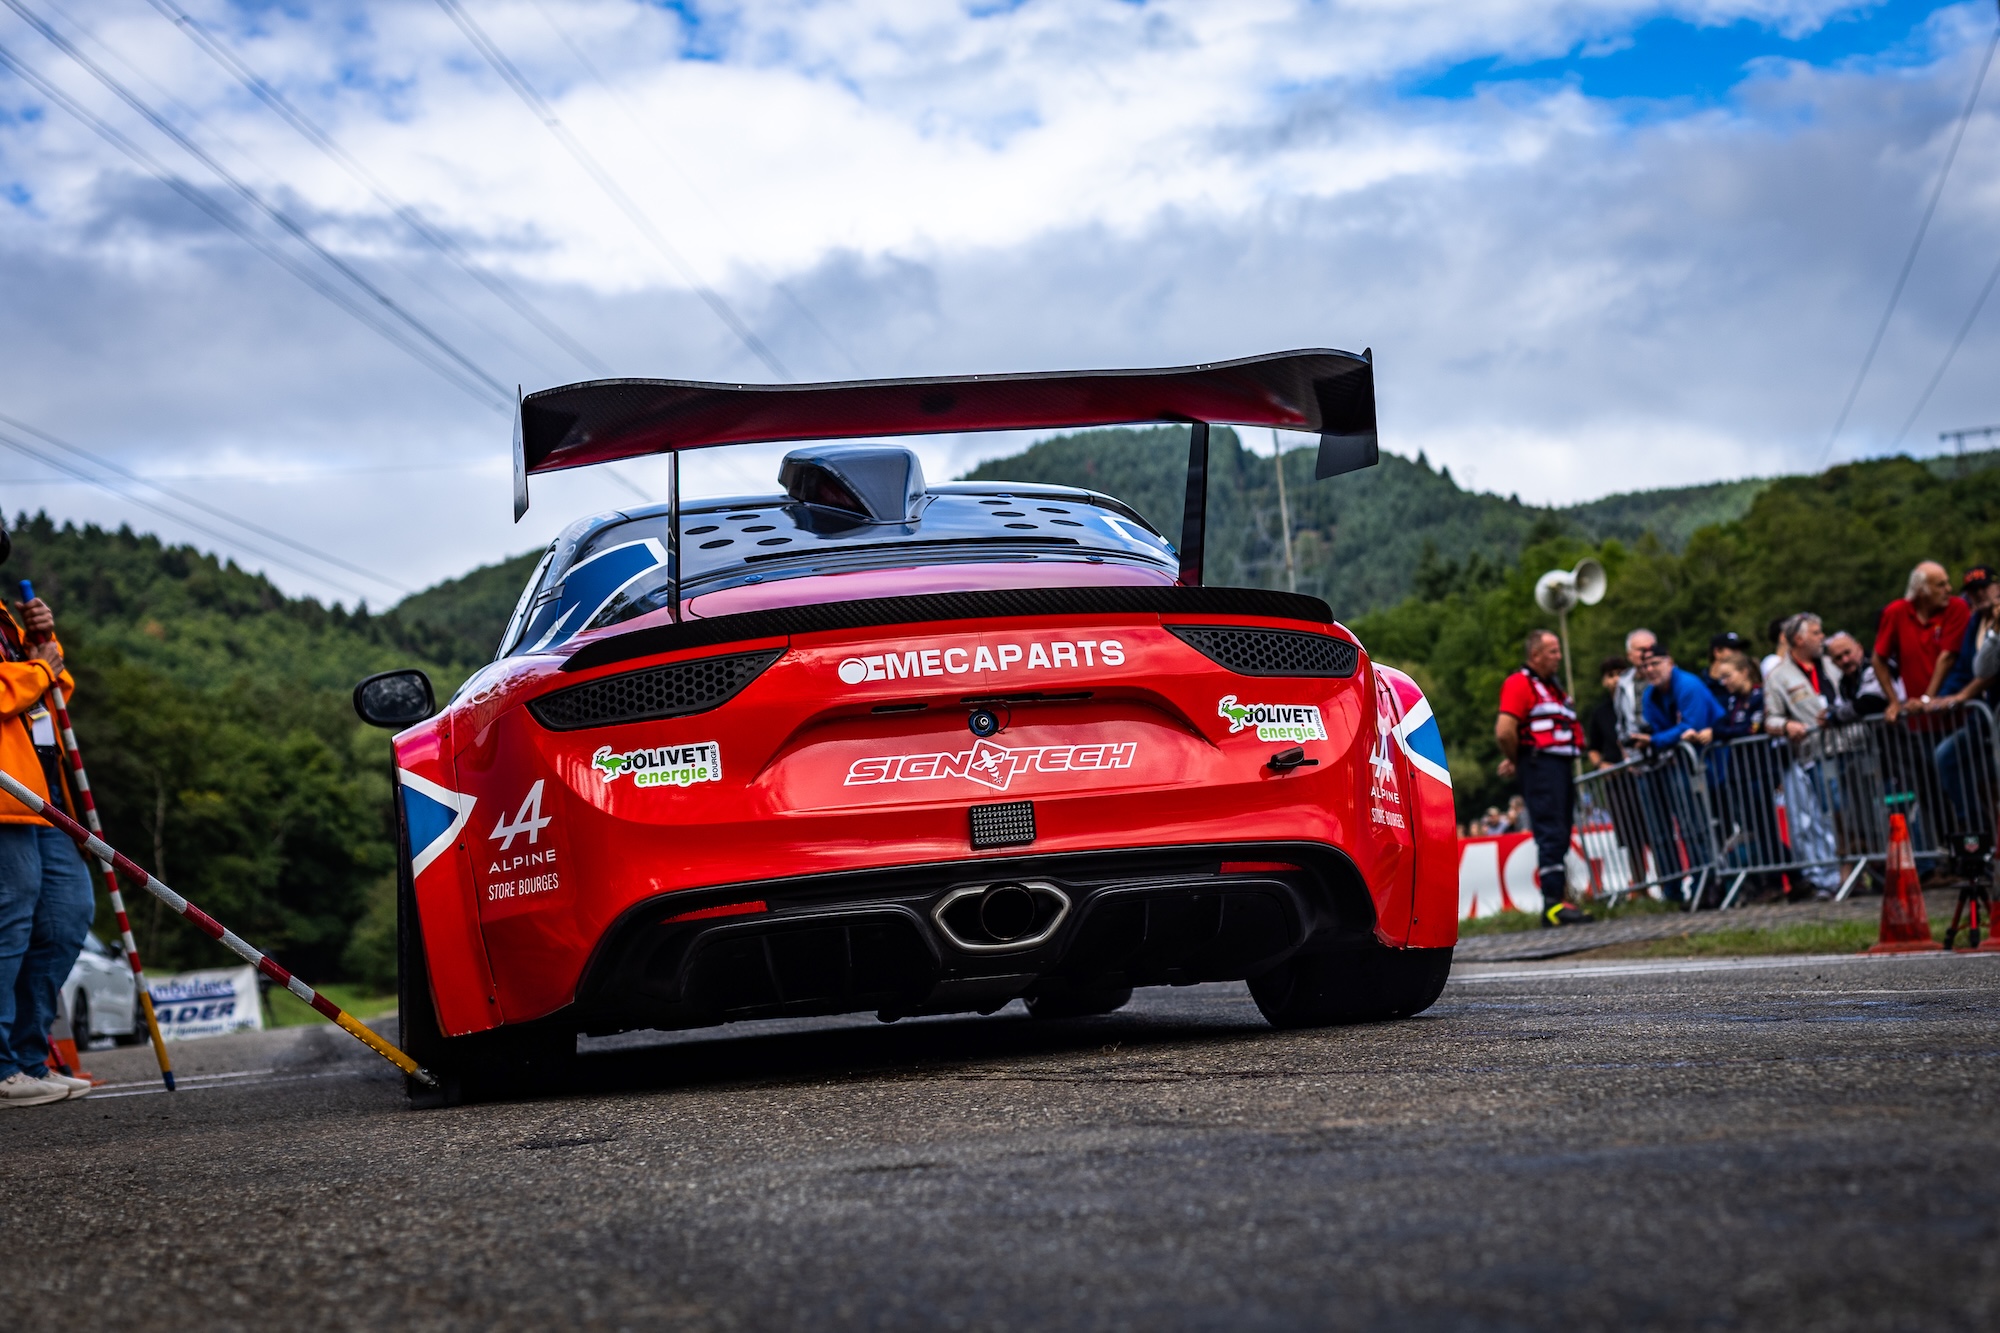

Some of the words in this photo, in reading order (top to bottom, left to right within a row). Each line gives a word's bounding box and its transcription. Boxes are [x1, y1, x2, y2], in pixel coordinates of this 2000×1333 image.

[885, 639, 1126, 680] MECAPARTS
[1244, 707, 1313, 723] JOLIVET
[1260, 723, 1316, 741] energie
[621, 745, 710, 771] JOLIVET
[709, 744, 719, 778] BOURGES
[637, 763, 708, 784] energie
[1370, 786, 1400, 804] ALPINE
[488, 849, 557, 875] ALPINE
[488, 881, 516, 901] STORE
[518, 872, 559, 896] BOURGES
